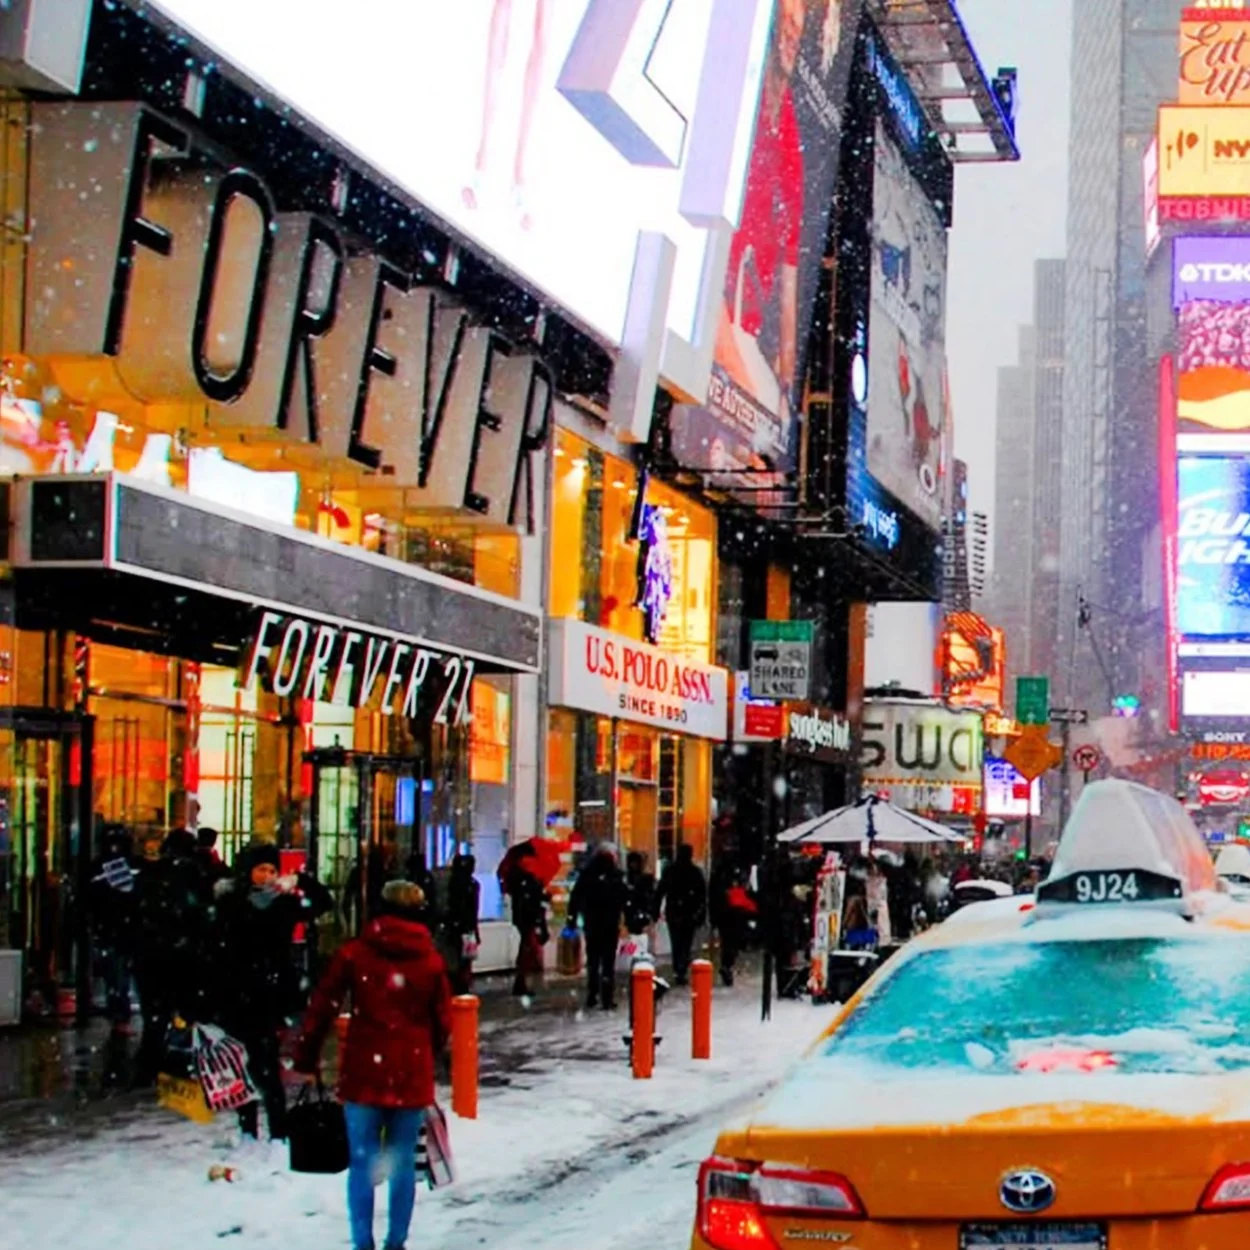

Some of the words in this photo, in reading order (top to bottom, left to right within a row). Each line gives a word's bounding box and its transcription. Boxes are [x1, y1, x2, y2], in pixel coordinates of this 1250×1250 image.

[102, 103, 556, 536] FOREVER
[243, 611, 430, 720] FOREVER
[433, 657, 476, 725] 21
[586, 635, 620, 681] U.S.
[622, 646, 669, 693] POLO
[671, 666, 715, 706] ASSN.
[754, 665, 806, 681] SHARED
[761, 682, 797, 695] LANE
[618, 693, 656, 717] SINCE
[660, 702, 688, 724] 1890
[789, 708, 833, 752] sunglass
[1203, 732, 1246, 742] SONY
[1076, 872, 1139, 902] 9J24
